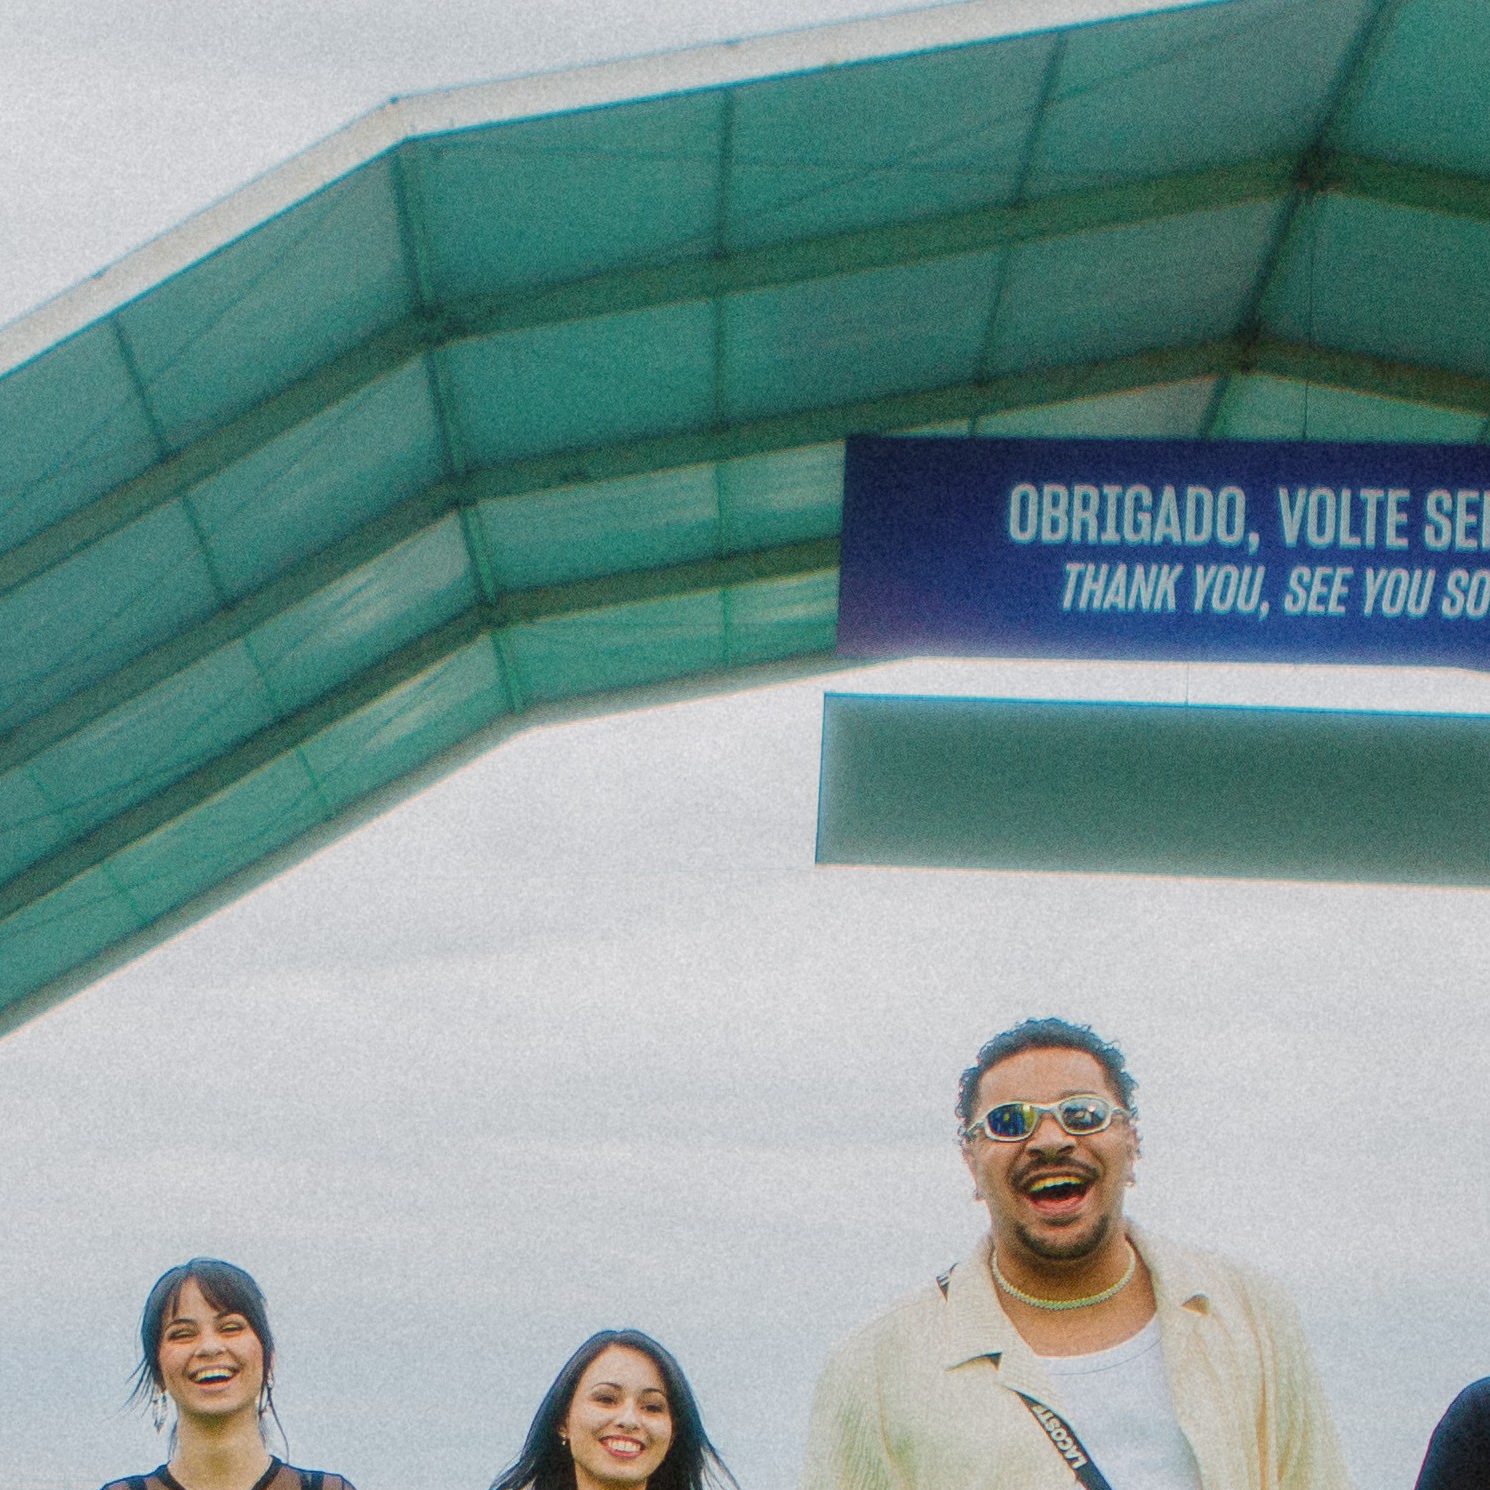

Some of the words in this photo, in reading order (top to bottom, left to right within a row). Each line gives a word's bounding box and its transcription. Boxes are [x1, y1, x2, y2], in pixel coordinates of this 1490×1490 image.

[1009, 483, 1261, 555] OBRIGADO,
[1277, 485, 1410, 551] VOLTE
[1062, 561, 1184, 613] THANK
[1192, 563, 1270, 621] YOU,
[1283, 565, 1355, 618] SEE
[1363, 566, 1437, 619] YOU
